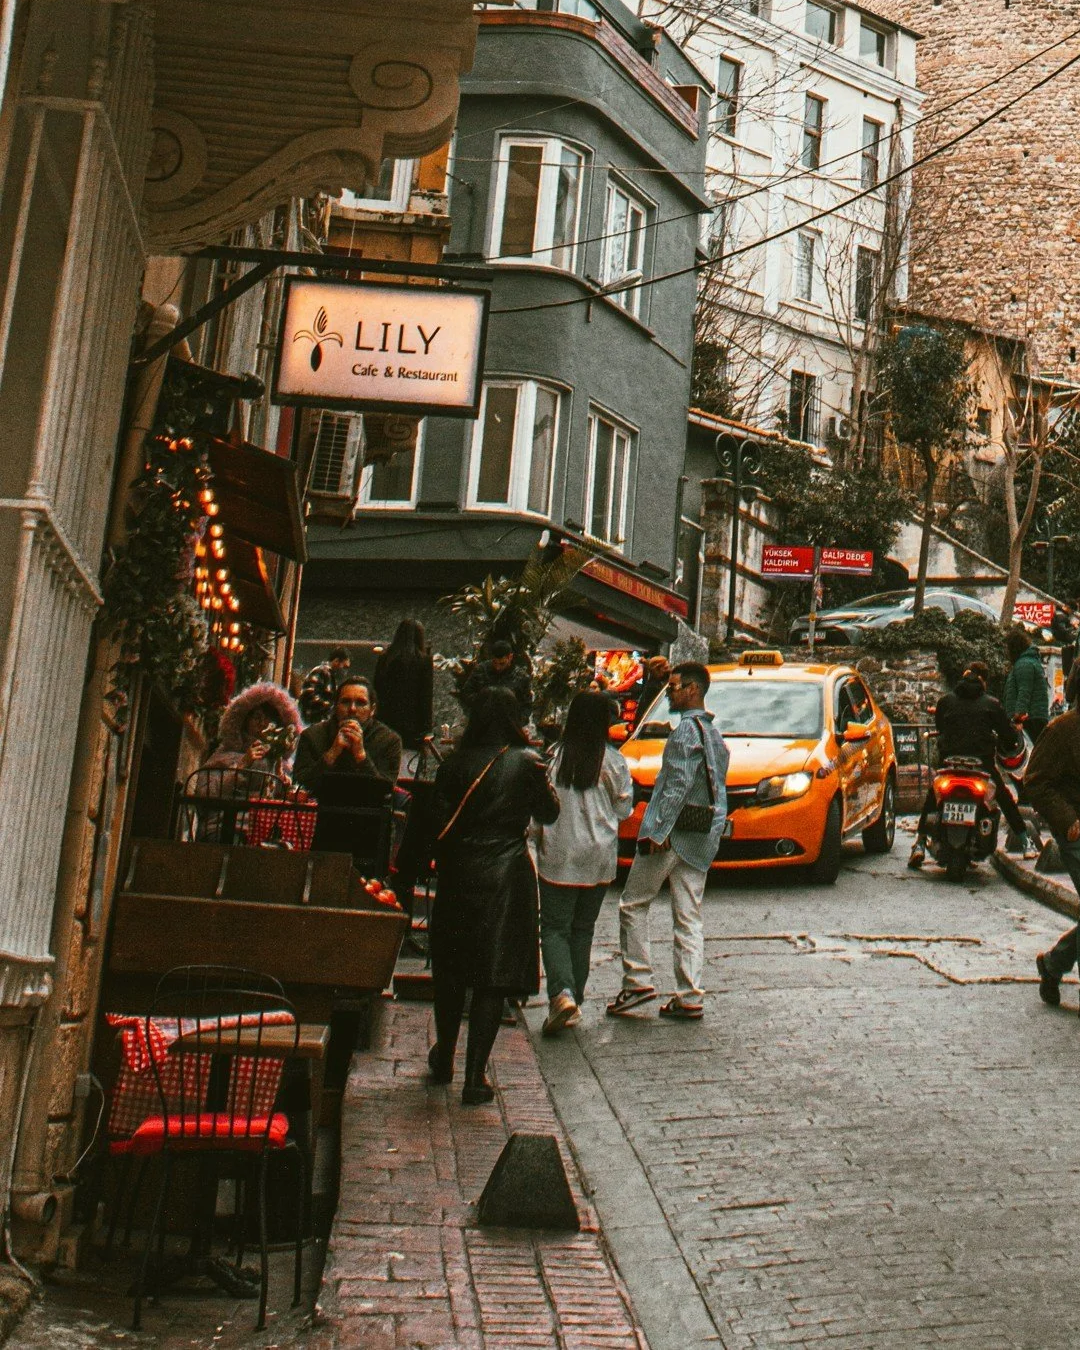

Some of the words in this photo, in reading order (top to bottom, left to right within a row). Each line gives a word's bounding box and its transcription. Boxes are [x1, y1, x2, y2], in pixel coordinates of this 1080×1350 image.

[355, 320, 441, 355] LILY
[351, 363, 379, 377] Cafe
[384, 366, 394, 378] &
[397, 367, 458, 382] Restaurant
[764, 548, 793, 557] YÜKSEK
[846, 553, 866, 561] DEDE
[764, 559, 799, 567] KALDIRIM
[1013, 604, 1051, 612] KULE
[1024, 611, 1043, 620] WC
